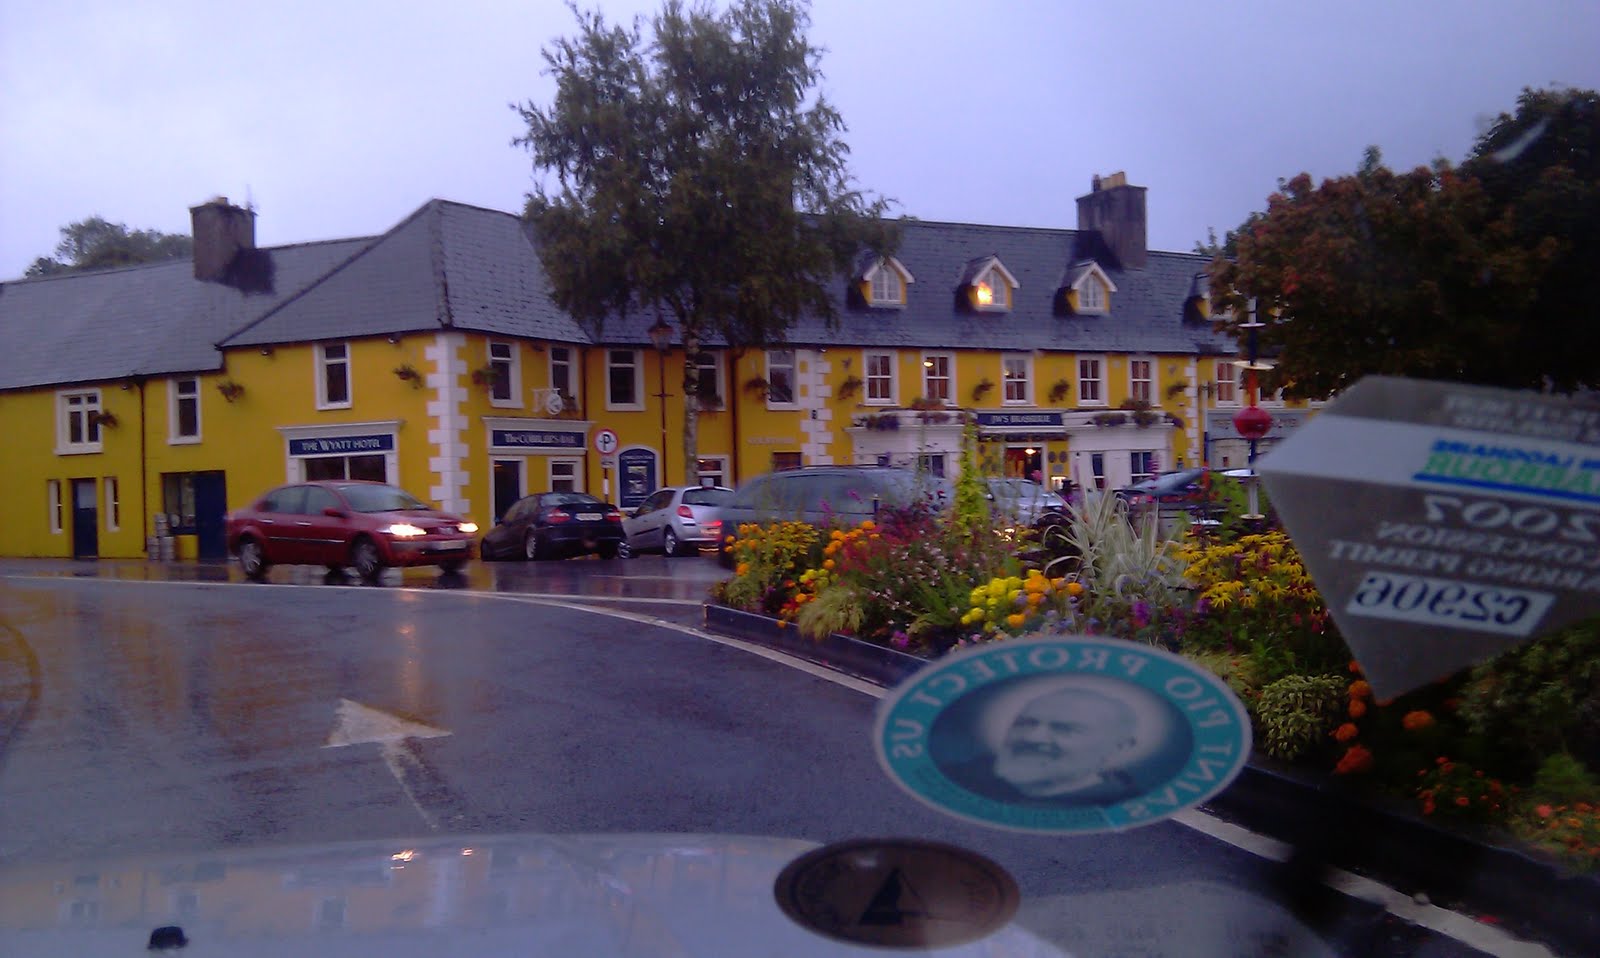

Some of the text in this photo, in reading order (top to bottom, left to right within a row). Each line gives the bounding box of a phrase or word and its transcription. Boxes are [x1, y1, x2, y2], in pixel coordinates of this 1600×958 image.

[302, 439, 380, 451] THE WYATT HOTEL
